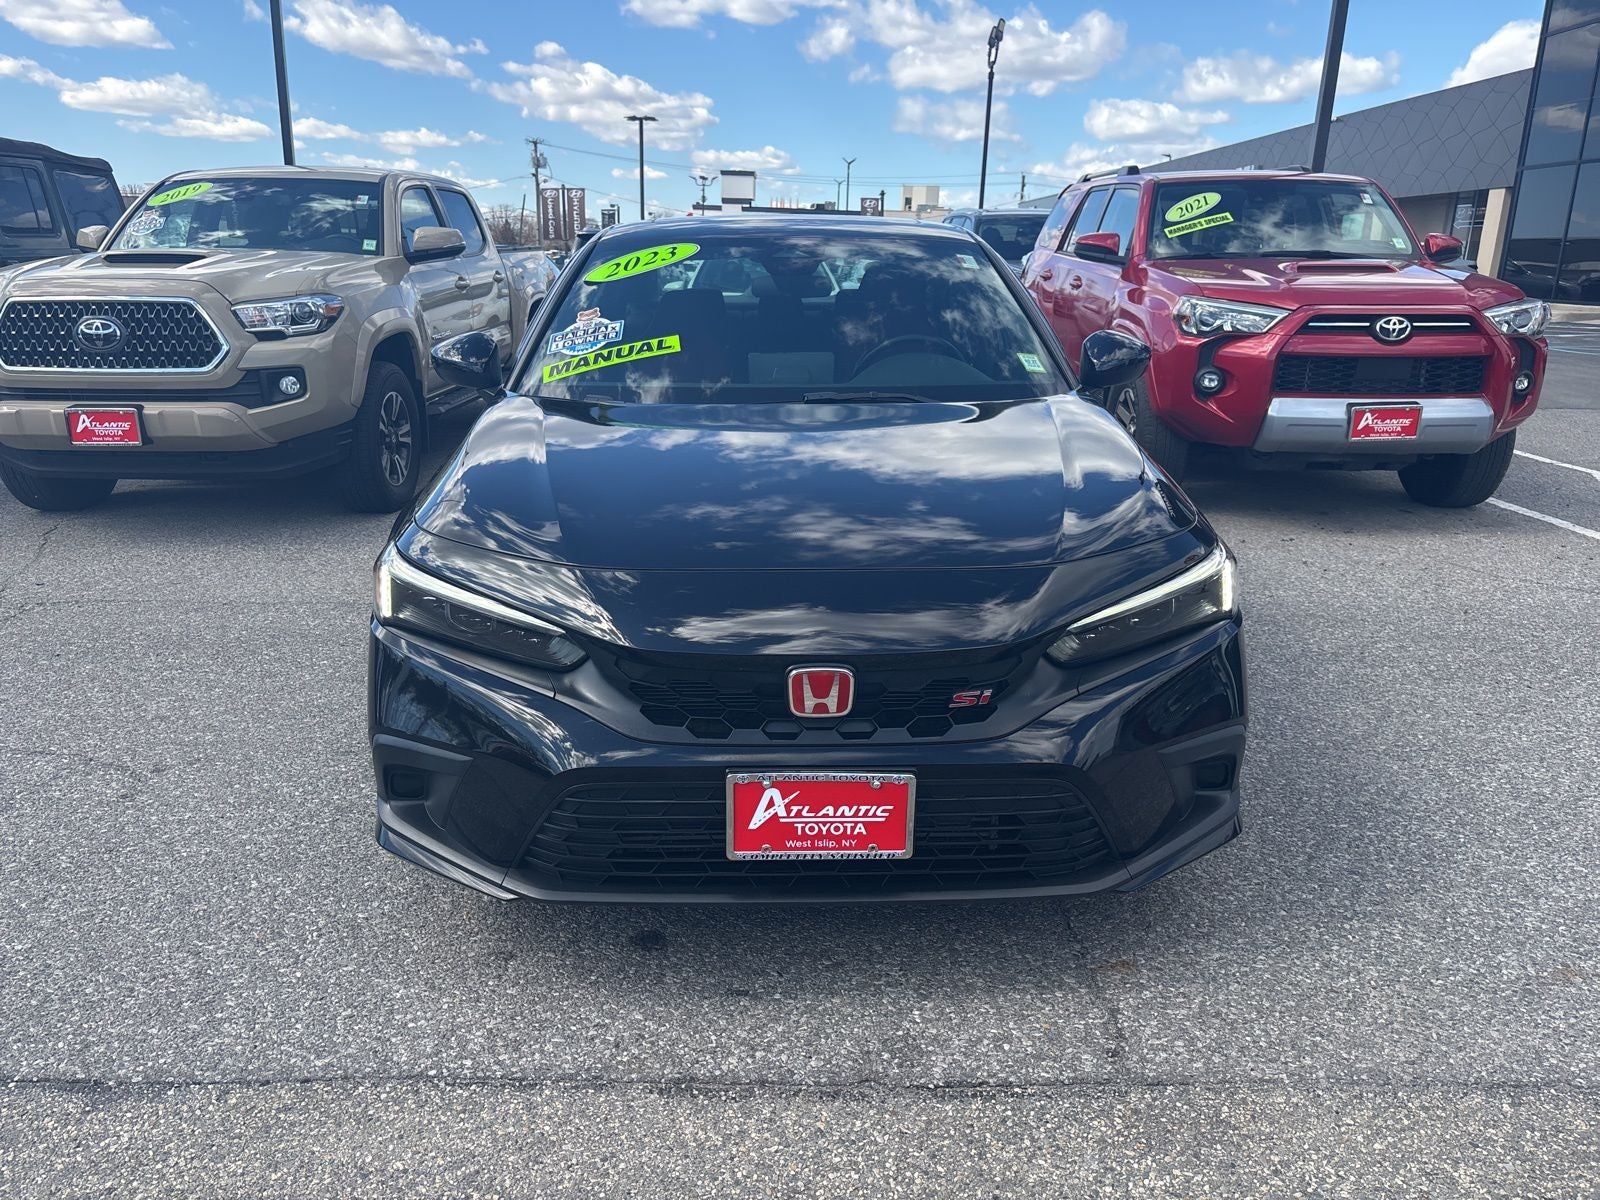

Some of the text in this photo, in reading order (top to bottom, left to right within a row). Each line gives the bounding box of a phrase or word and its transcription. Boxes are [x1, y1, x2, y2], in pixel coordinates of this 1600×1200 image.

[159, 184, 202, 203] 2019
[1176, 195, 1209, 218] 2021
[547, 198, 556, 239] Used Cars
[572, 198, 581, 237] HYUNDA
[1167, 215, 1231, 235] MANAGER'S SPECIAL
[605, 246, 678, 279] 2023
[555, 326, 617, 341] CARFAX
[565, 332, 616, 347] OWNER
[549, 338, 673, 378] MANUAL
[76, 414, 131, 433] ATLANTIC
[1357, 412, 1414, 431] ATLANTIC
[949, 689, 993, 708] Si
[748, 787, 894, 829] ATLANTIC
[793, 823, 867, 835] TOYOTA
[785, 839, 857, 848] West Islip, NY
